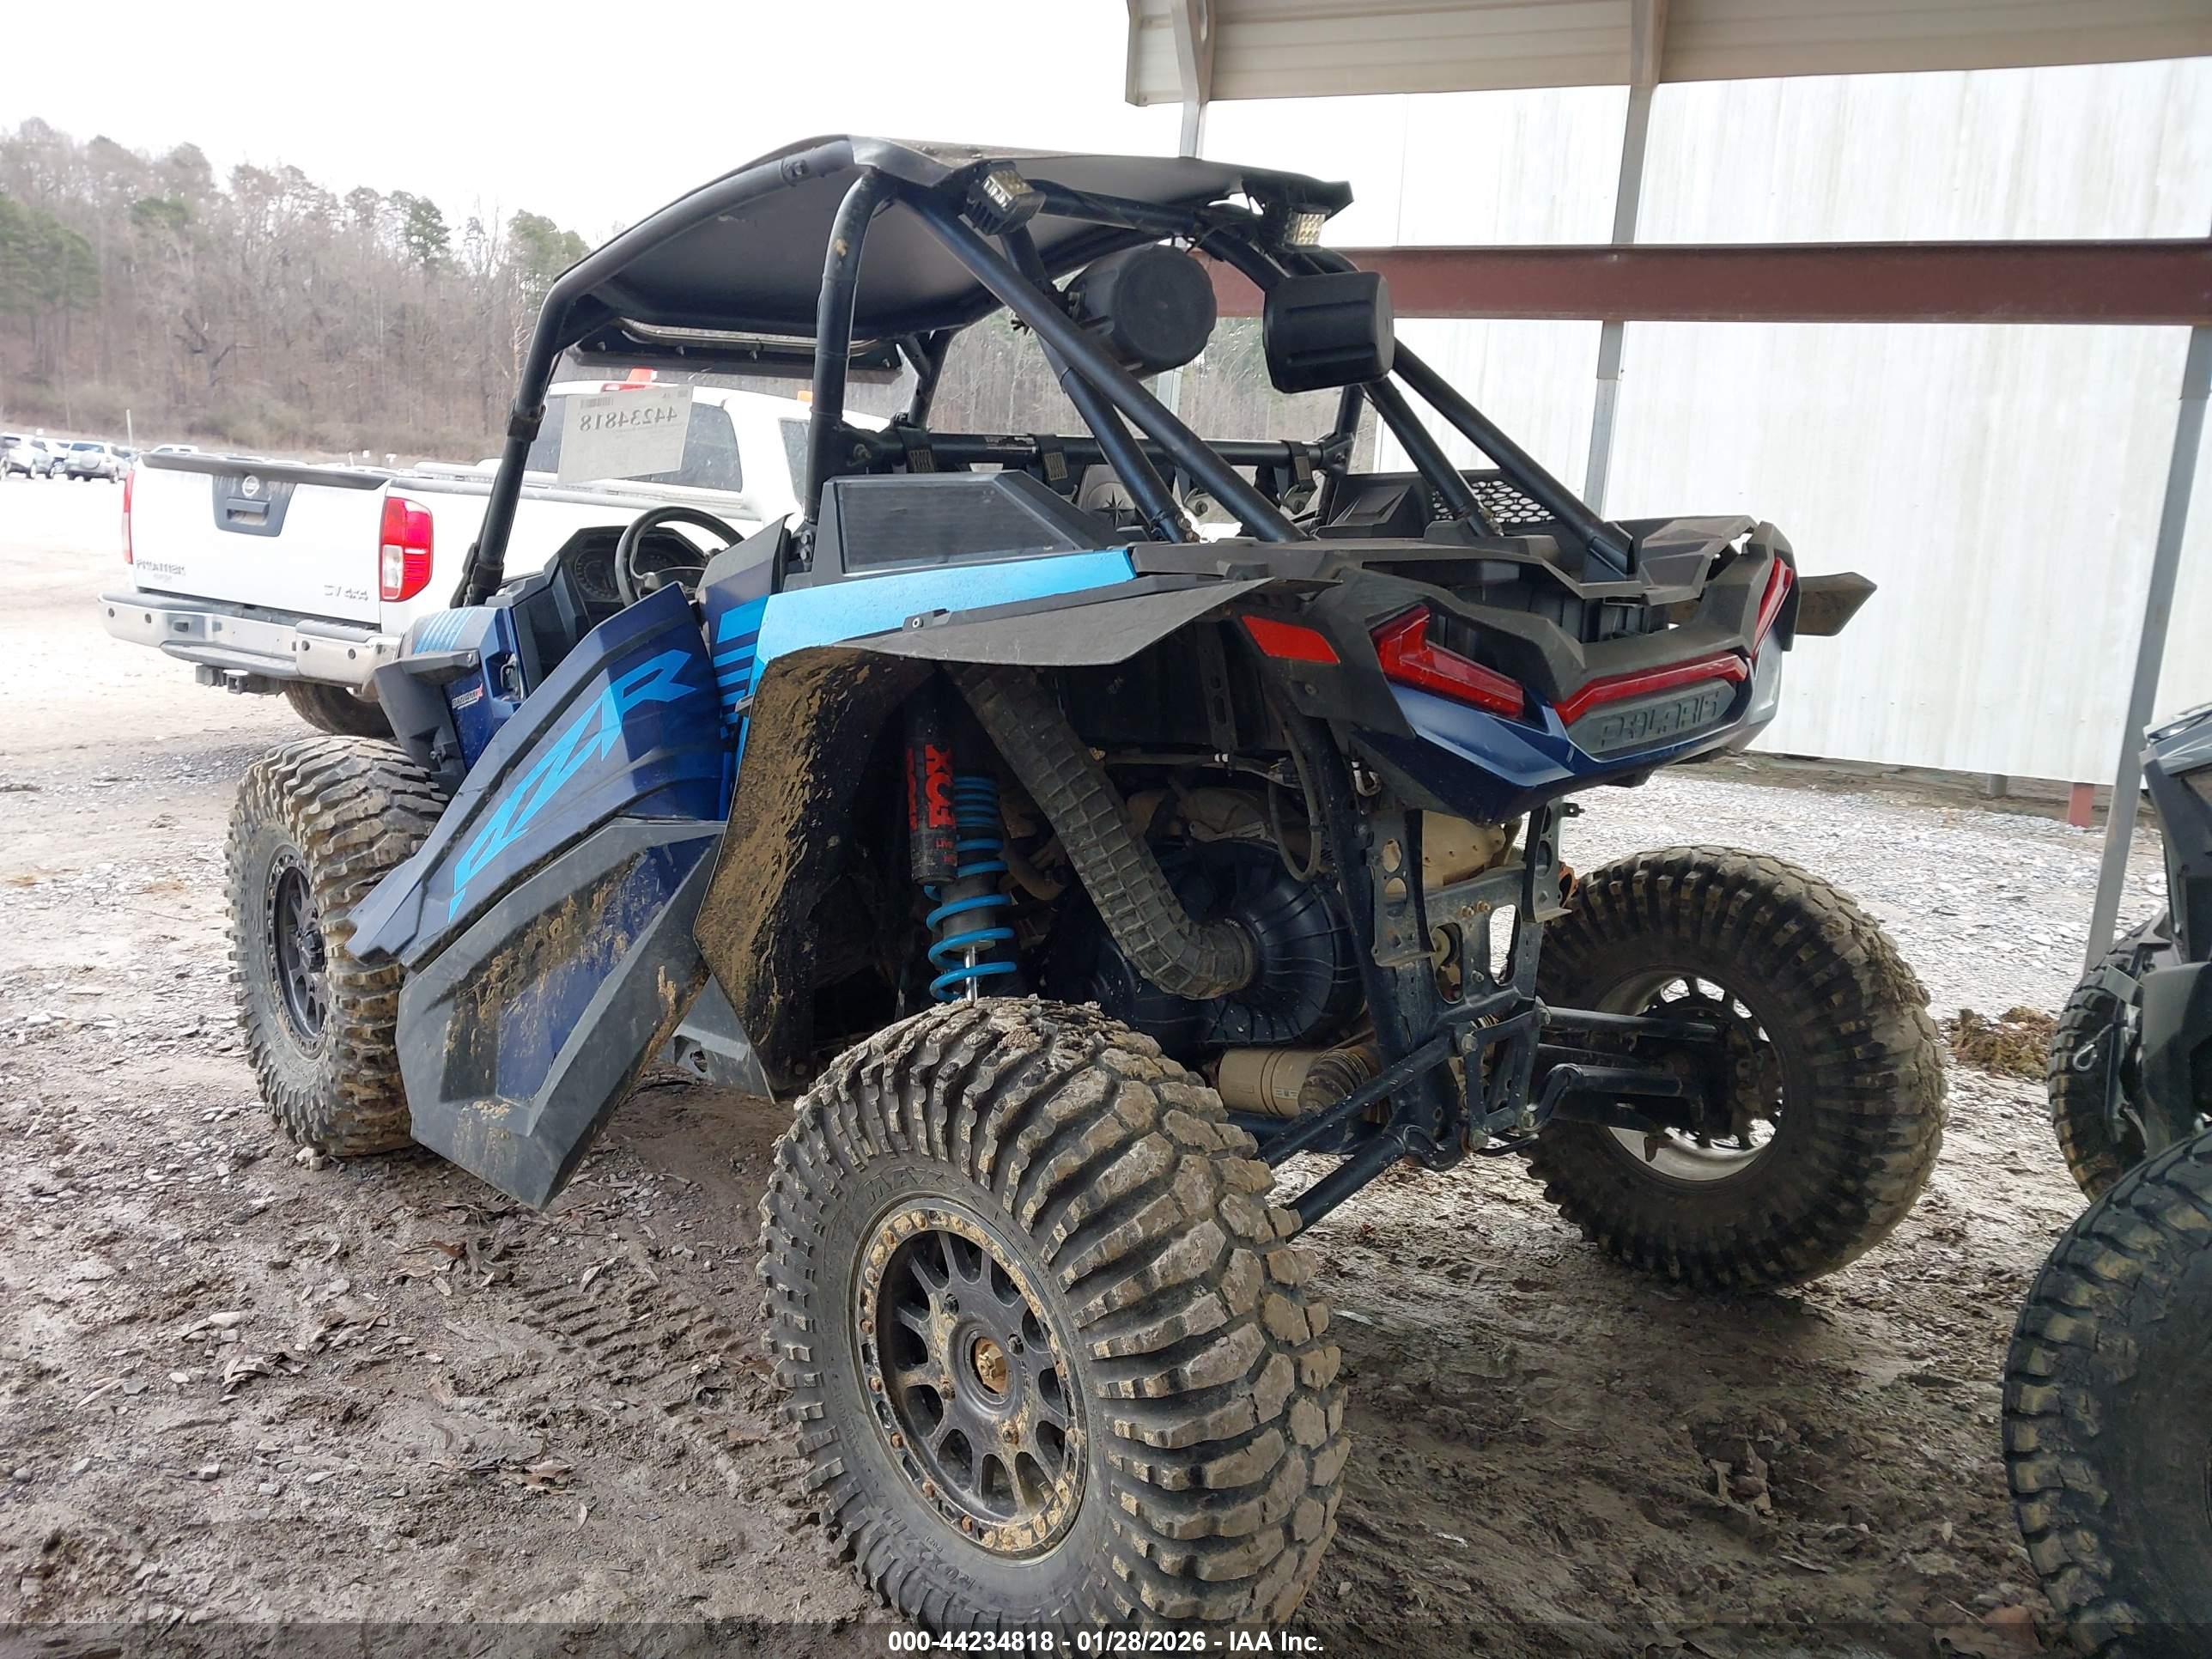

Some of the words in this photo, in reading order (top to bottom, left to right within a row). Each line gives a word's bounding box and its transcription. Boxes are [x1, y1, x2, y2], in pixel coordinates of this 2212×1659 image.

[1601, 690, 1720, 747] POLARIS
[448, 649, 698, 924] RZR
[925, 744, 957, 831] FOX
